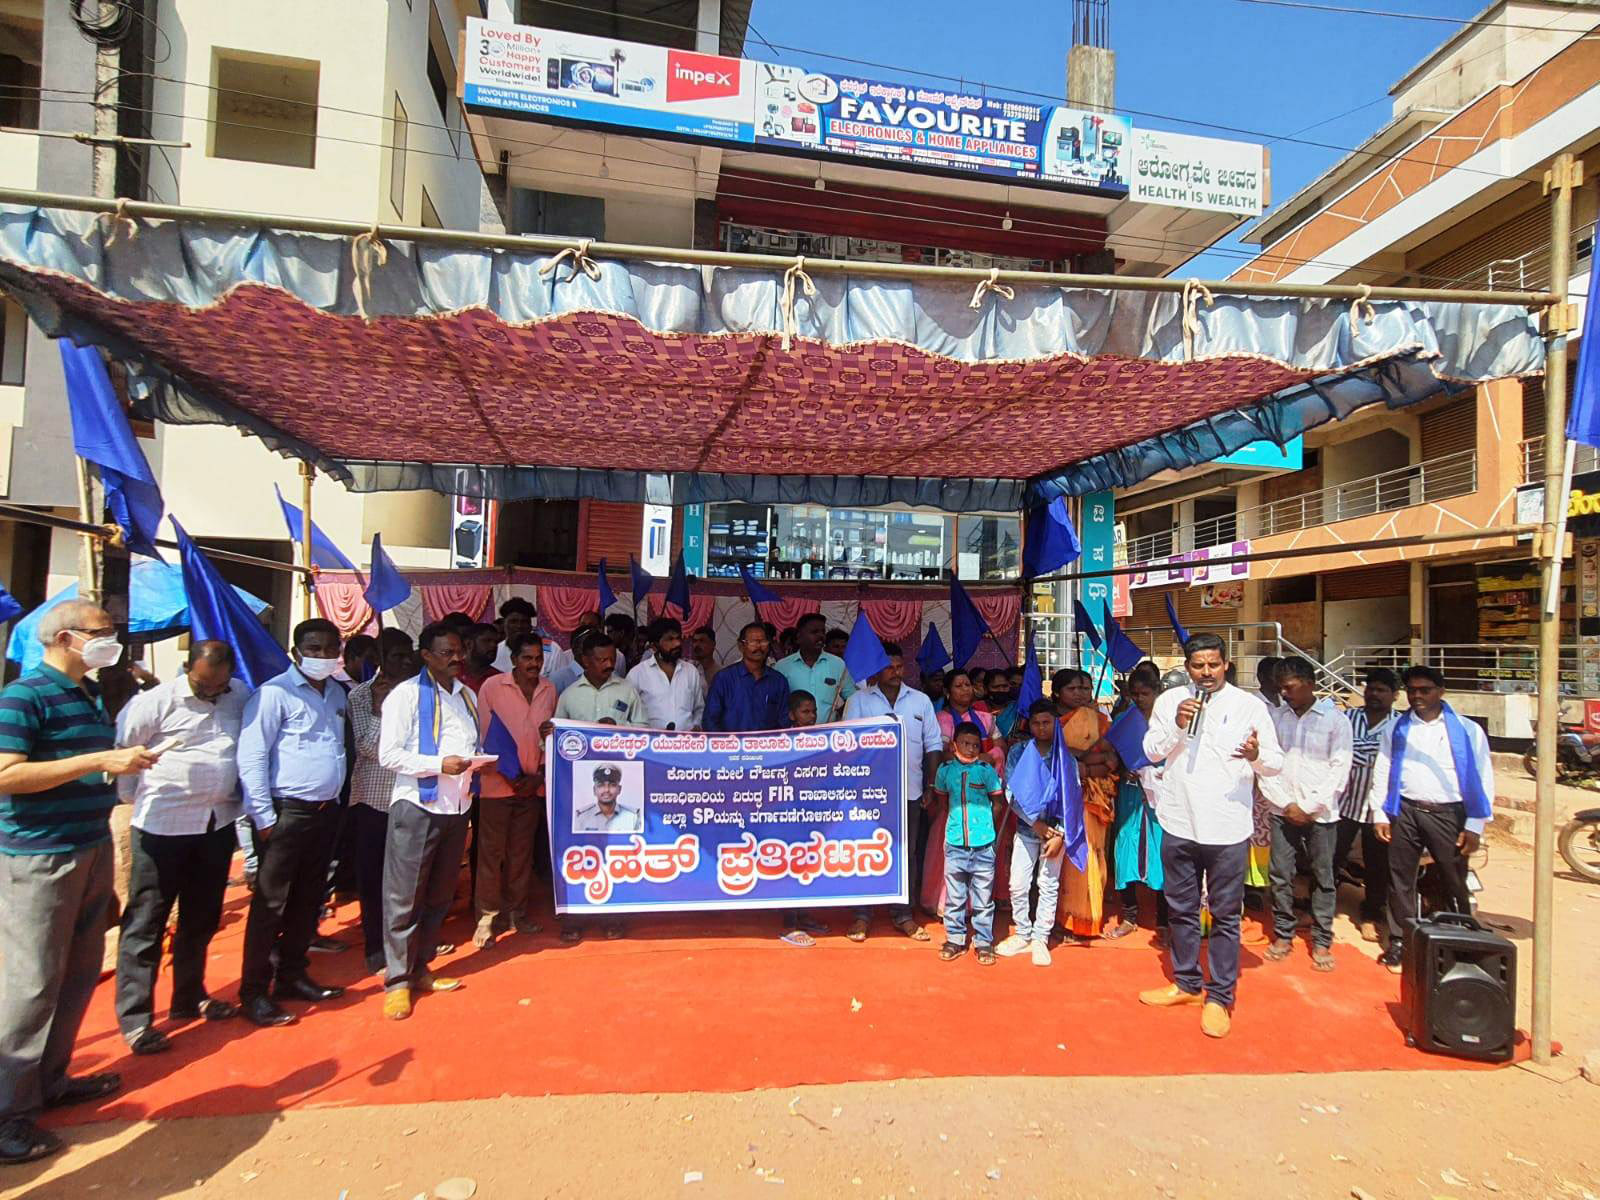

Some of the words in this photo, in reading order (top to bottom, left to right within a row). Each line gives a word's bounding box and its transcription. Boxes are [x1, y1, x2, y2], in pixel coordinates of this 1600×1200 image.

[480, 26, 521, 42] Loved
[525, 33, 542, 46] By
[480, 56, 541, 73] Customers
[507, 51, 541, 64] Happy
[480, 66, 541, 82] Worldwide!
[477, 87, 519, 99] FAVOURITE
[520, 92, 570, 106] ELECTRONICS
[478, 96, 501, 106] HOME
[503, 99, 549, 112] APPLIANCES
[841, 97, 1026, 142] FAVOURITE
[831, 119, 912, 142] ELECTRONICS
[917, 130, 925, 143] &
[929, 134, 961, 148] HOME
[966, 139, 1037, 158] APPLIANCES
[1138, 156, 1210, 189] ಆರೋಗ್ಯವೇ
[1217, 168, 1257, 190] ಜೀವನ
[1138, 186, 1188, 201] HEALTH
[1192, 191, 1203, 203] IS
[1208, 193, 1257, 209] WEALTH
[652, 733, 707, 752] ಯುವಸೇನೆ
[860, 729, 897, 748] ಉಡುಪಿ
[667, 766, 711, 780] ಕೊರಗರ
[717, 766, 744, 780] ಮೇಲೆ
[750, 764, 789, 785] ದೌರ್ಜನ್ಯ
[794, 765, 828, 779] ಎಸಗಿದ
[768, 785, 794, 802] FIR
[862, 786, 888, 804] ಮತ್ತು
[662, 813, 687, 829] ಜಿಲ್ಲಾ
[693, 808, 745, 828] SPಯನ್ನು
[849, 806, 880, 822] ಕೋರಿ
[562, 834, 699, 904] ಬೃಹತ್
[717, 828, 893, 895] ಪ್ರತಿಭಟನೆ
